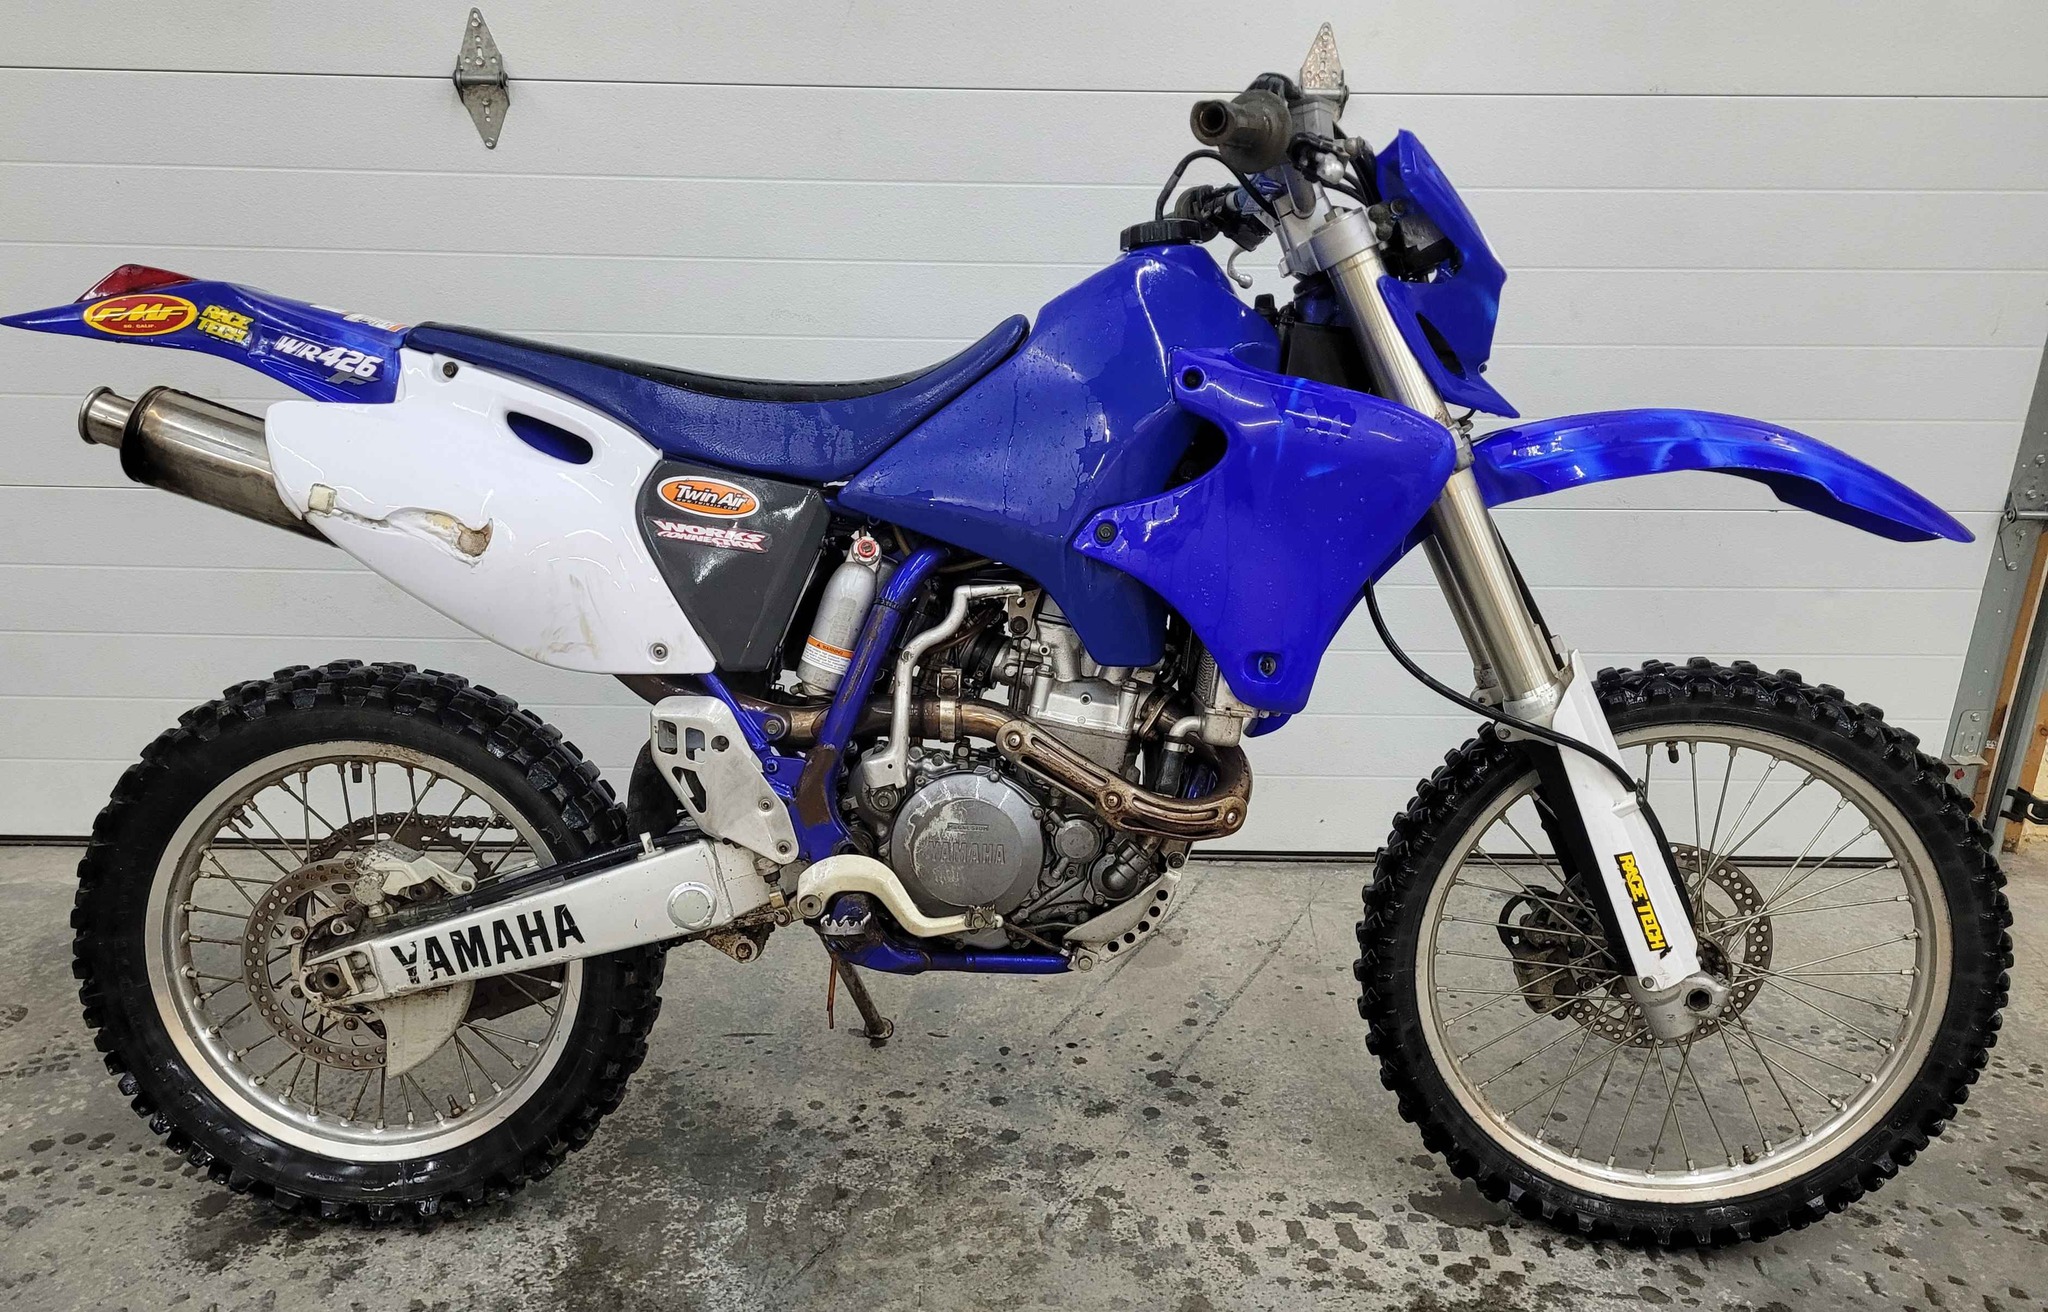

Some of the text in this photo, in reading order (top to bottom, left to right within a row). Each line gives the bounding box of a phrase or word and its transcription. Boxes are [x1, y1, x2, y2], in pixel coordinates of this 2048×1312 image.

[91, 303, 189, 322] FMF
[201, 304, 254, 330] RACE
[197, 316, 248, 343] TECH
[274, 335, 384, 377] WR426
[675, 484, 746, 508] Twin Air
[652, 519, 766, 543] WORKS
[657, 531, 764, 552] CONNECTION
[929, 841, 1006, 864] YAMAHA
[1614, 852, 1668, 951] RACE TECH
[390, 904, 586, 985] YAMAHA
